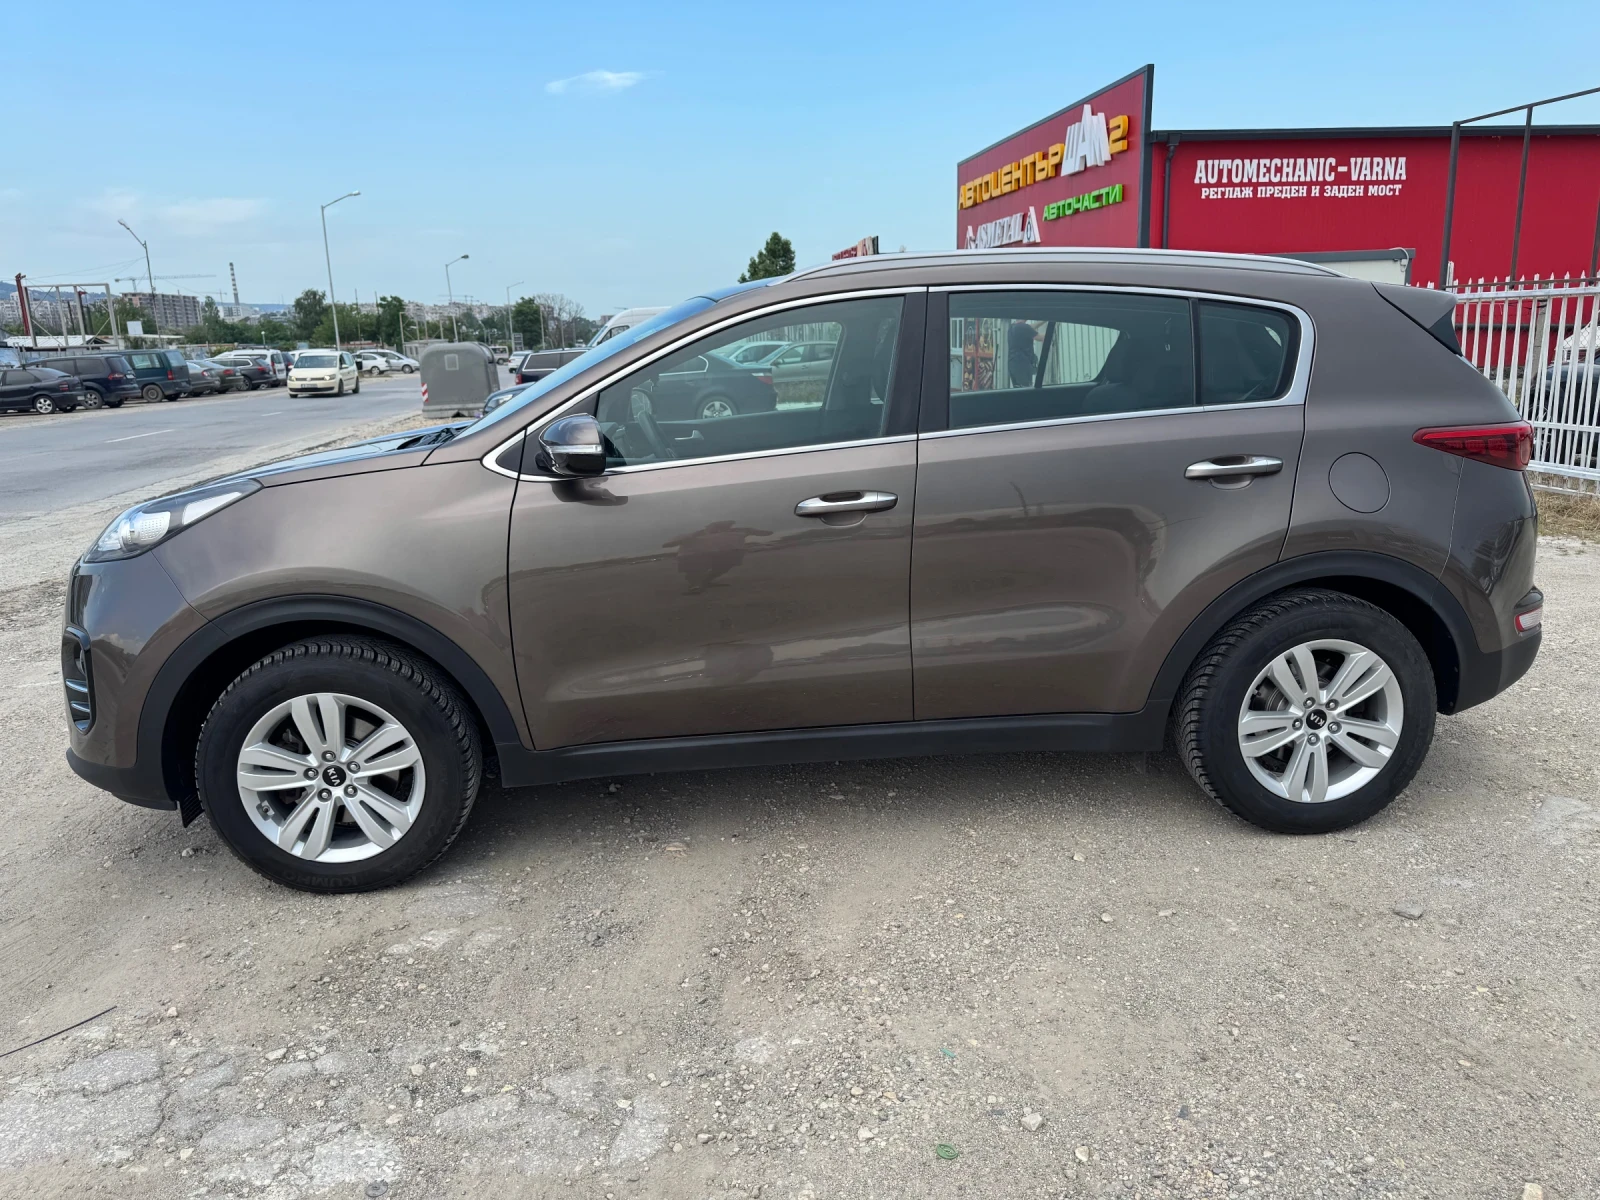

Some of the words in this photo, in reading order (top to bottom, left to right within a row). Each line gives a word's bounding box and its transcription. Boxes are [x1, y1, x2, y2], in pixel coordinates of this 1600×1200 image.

[958, 142, 1064, 210] АВТОЦЕНТЪР
[1109, 115, 1128, 154] 2
[1201, 187, 1253, 199] РЕГЛАЖ
[1257, 185, 1307, 199] ПРЕДЕН
[1311, 185, 1320, 197] И
[1324, 184, 1364, 198] ЗАДЕН
[1368, 184, 1402, 196] МОСТ
[1042, 184, 1123, 221] АВТОЧАСТИ
[1310, 712, 1325, 727] KIA
[327, 767, 341, 786] KIA
